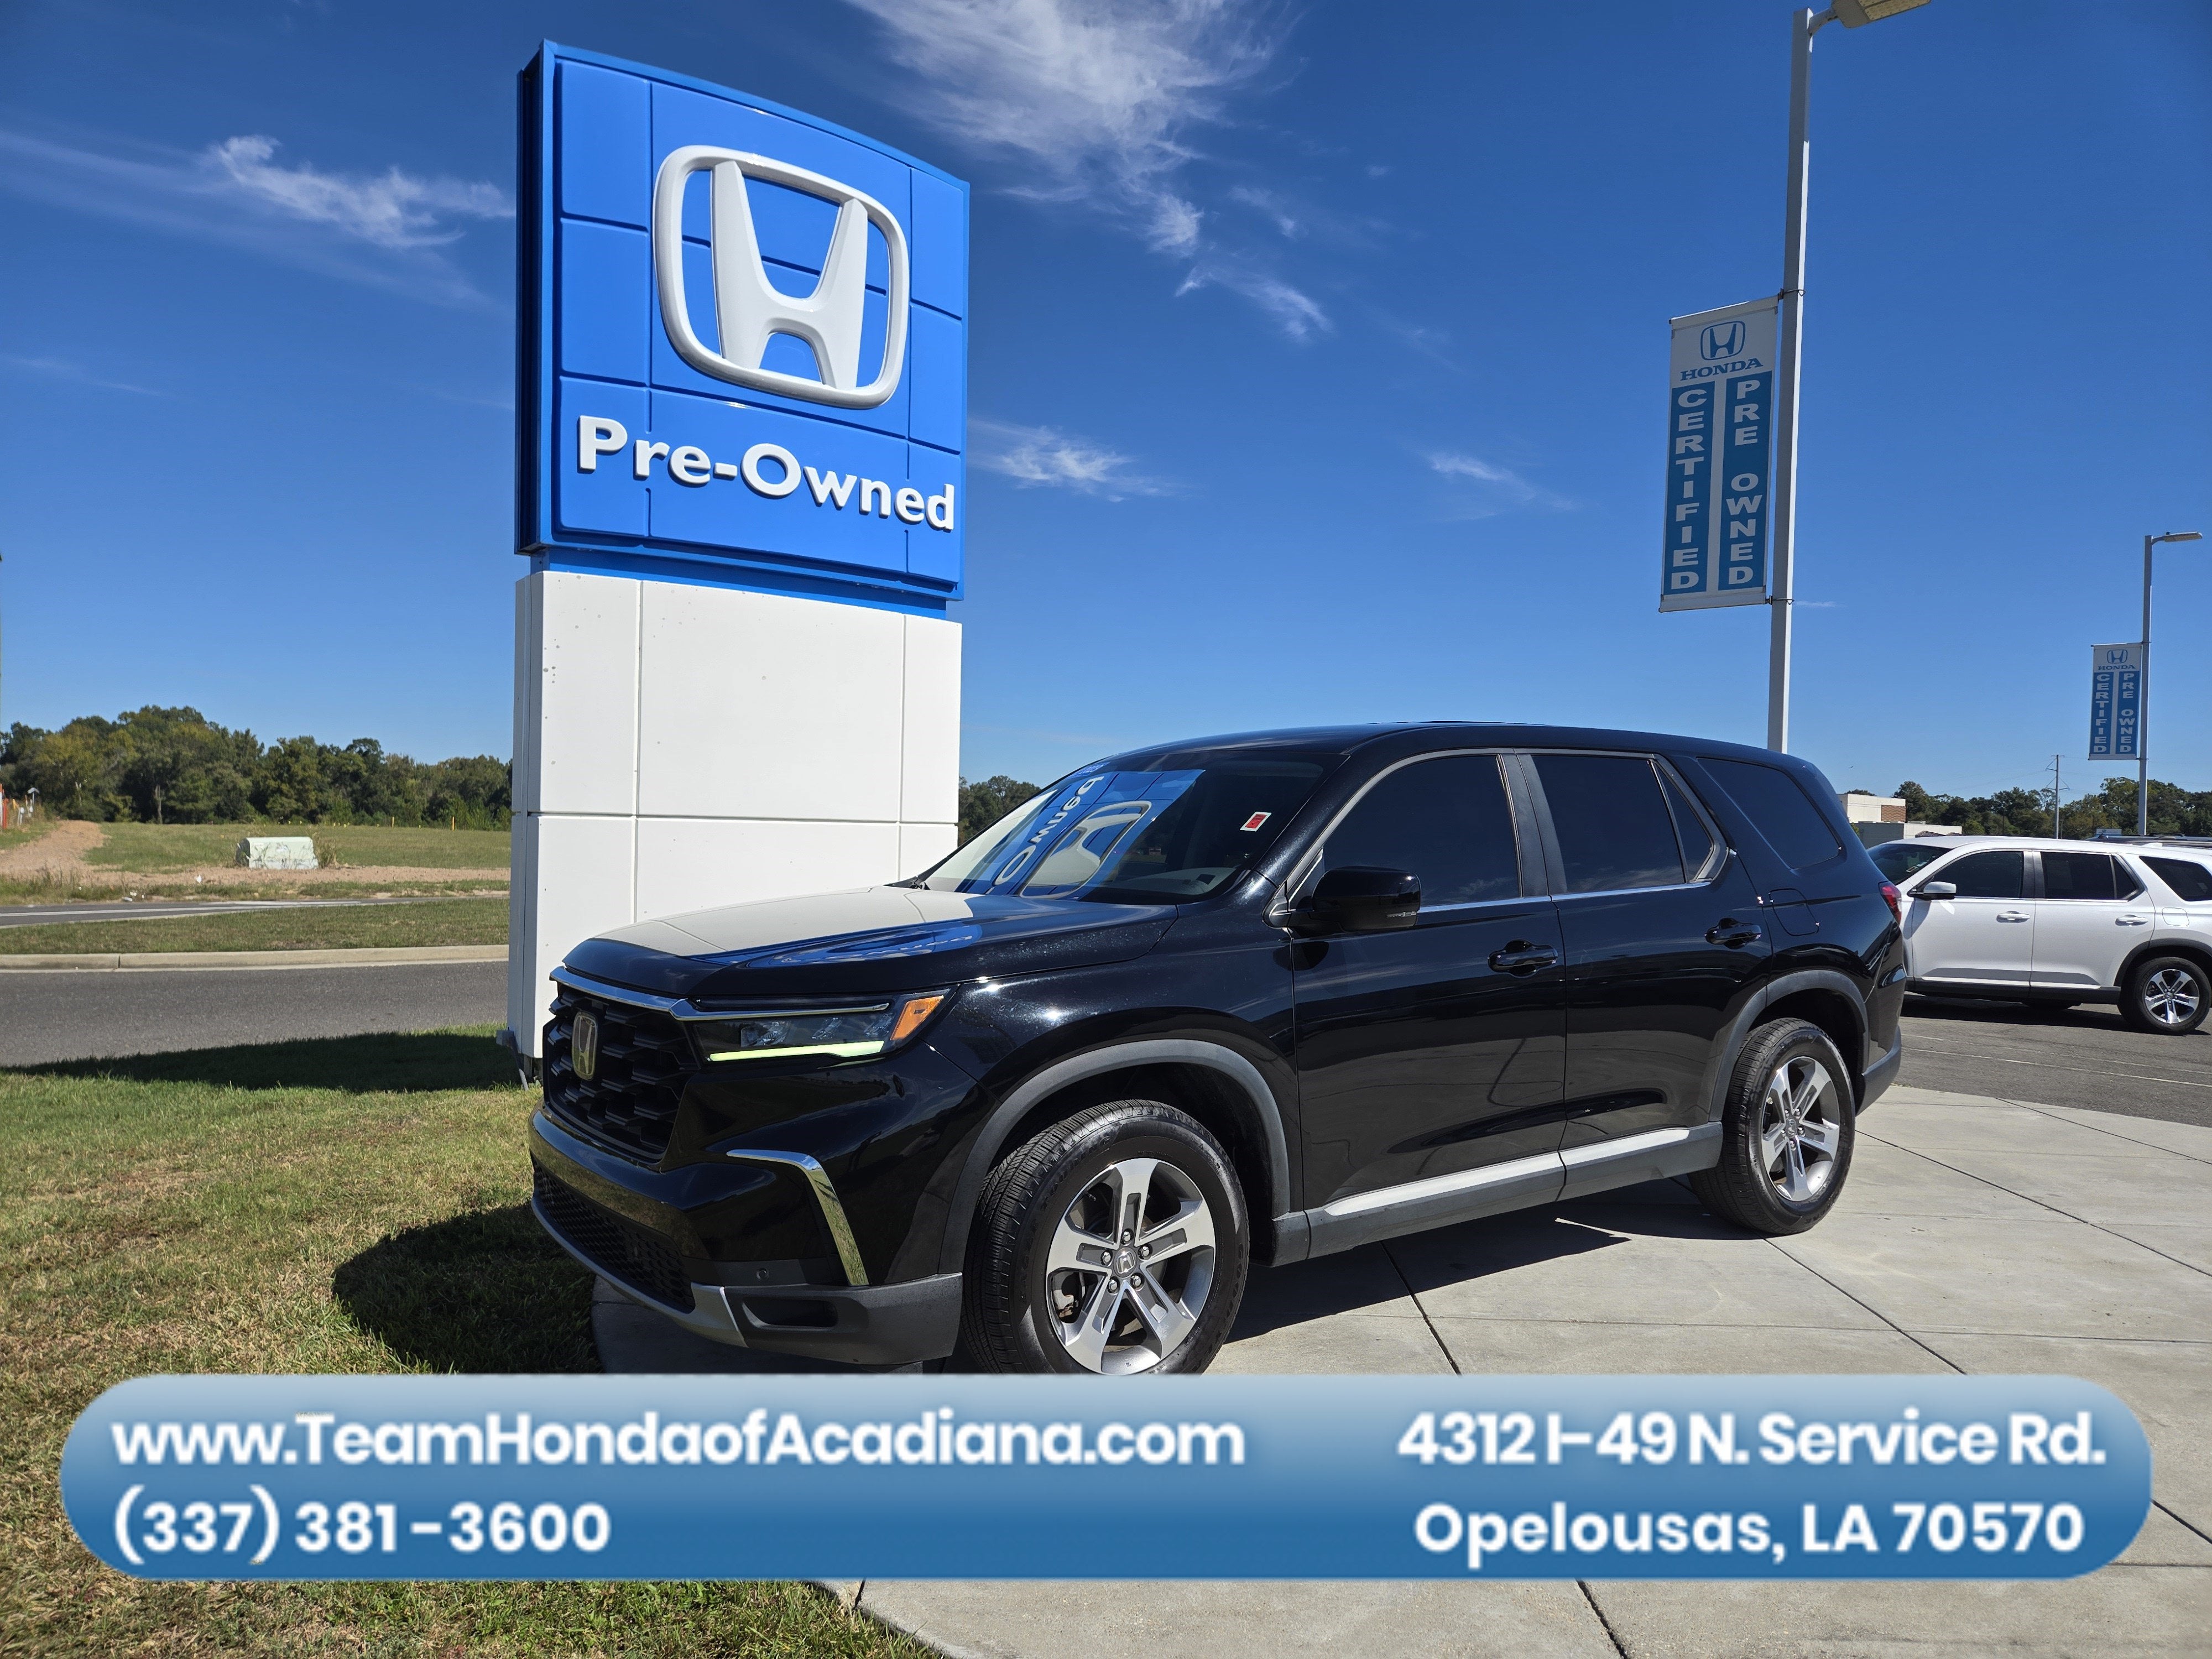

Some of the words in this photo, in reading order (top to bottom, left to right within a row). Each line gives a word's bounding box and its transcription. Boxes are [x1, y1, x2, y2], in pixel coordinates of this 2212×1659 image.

[1680, 358, 1764, 381] HONDA
[1734, 379, 1761, 446] PRE
[577, 414, 954, 531] Pre-Owned
[1670, 389, 1708, 591] CERTIFIED
[1725, 473, 1763, 586] OWNED
[2093, 674, 2110, 753] CERTIFIED
[2122, 673, 2135, 699] PRE
[2118, 709, 2136, 753] OWNED
